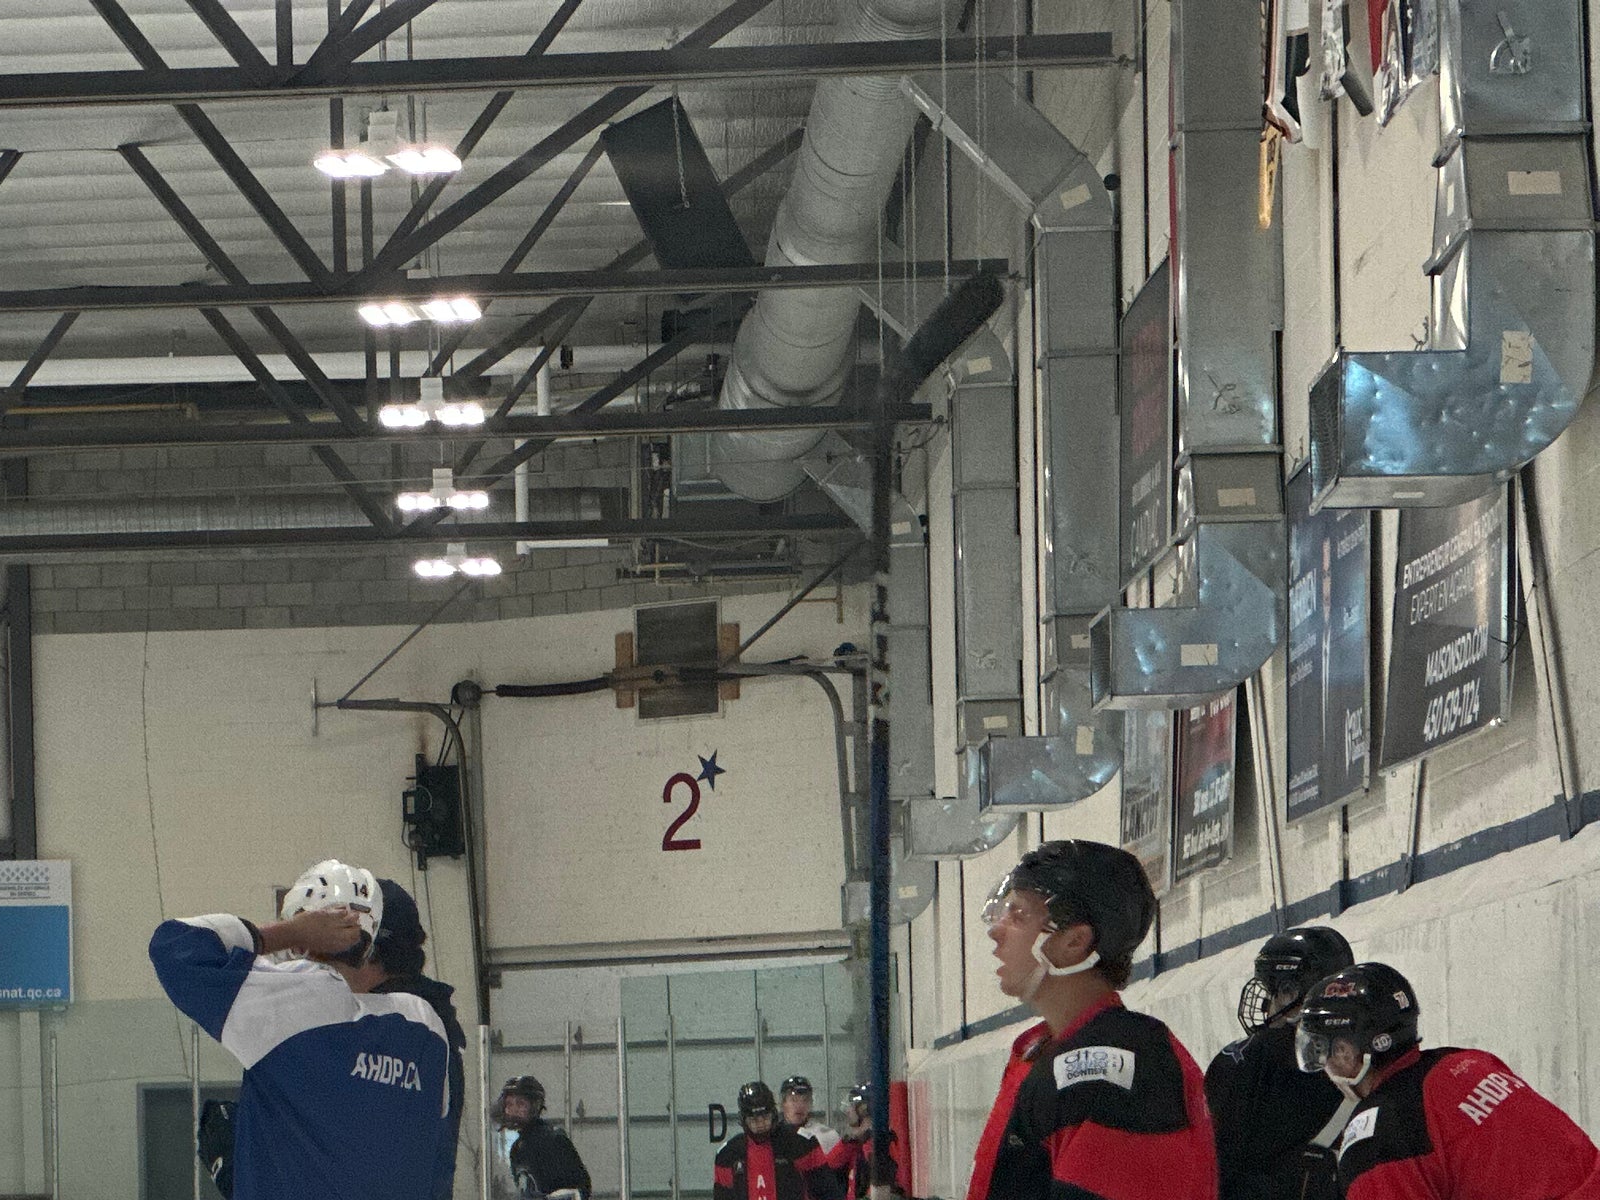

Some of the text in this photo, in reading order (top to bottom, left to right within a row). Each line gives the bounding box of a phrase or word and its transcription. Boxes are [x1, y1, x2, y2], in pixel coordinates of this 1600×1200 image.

[1423, 677, 1480, 742] 450 619-1124
[662, 772, 702, 851] 2
[353, 882, 368, 897] 14
[351, 1052, 422, 1092] AHDP.CA
[709, 1104, 727, 1143] D
